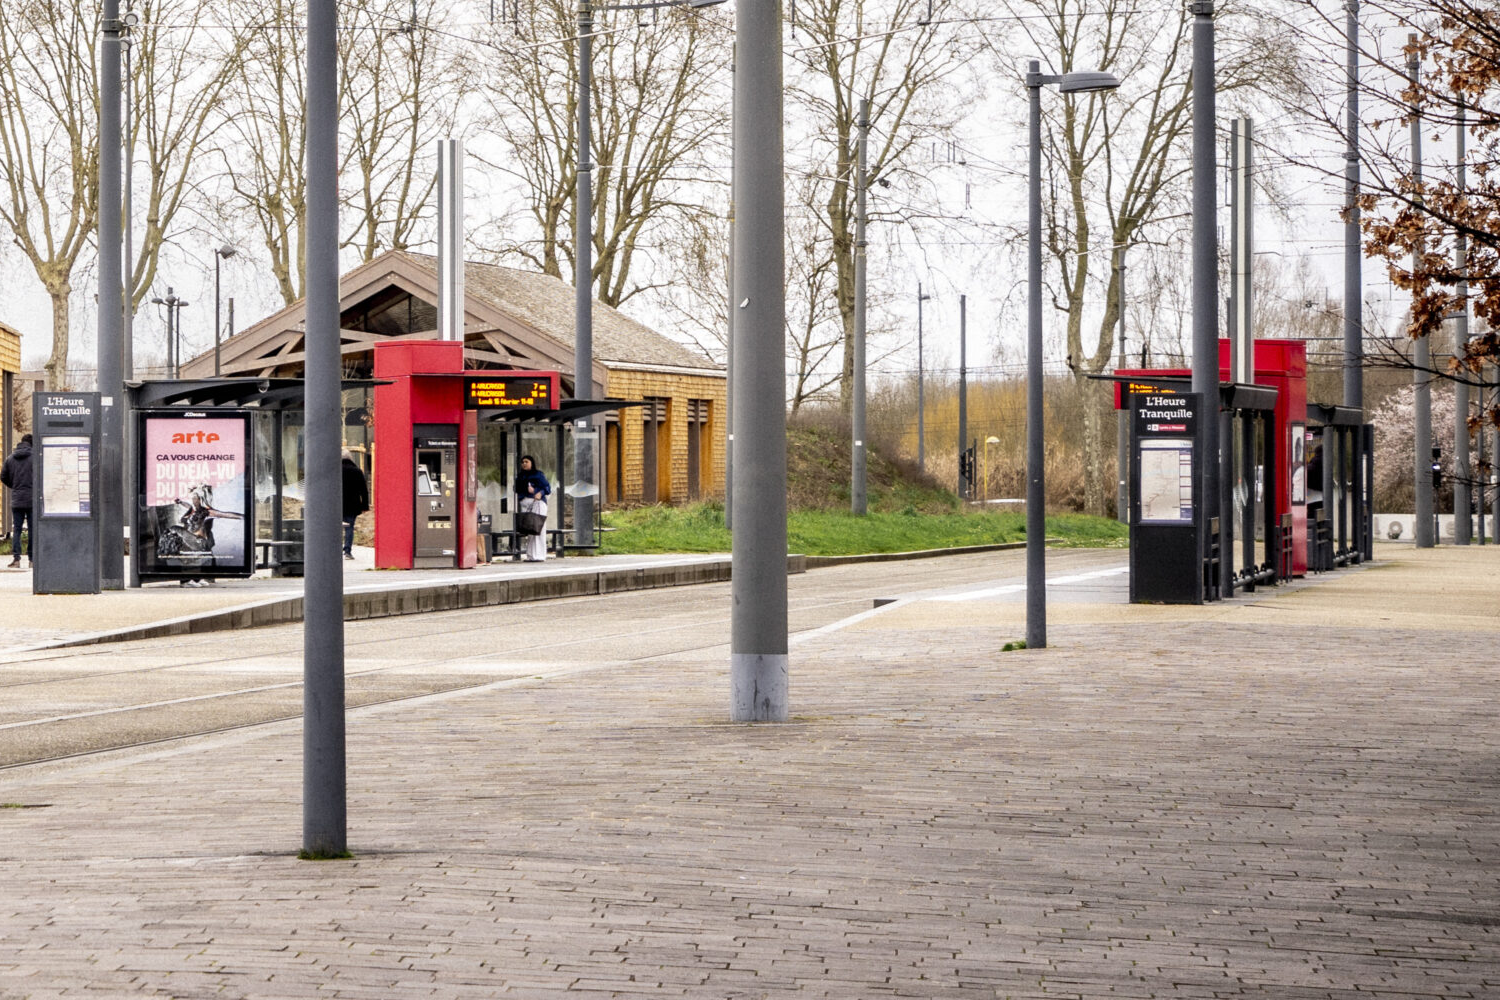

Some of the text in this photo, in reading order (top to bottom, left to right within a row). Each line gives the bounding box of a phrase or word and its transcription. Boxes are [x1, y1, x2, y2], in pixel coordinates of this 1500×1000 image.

[47, 397, 84, 406] L'Heure
[1146, 397, 1186, 406] L'Heure
[42, 407, 91, 417] Tranquille
[1139, 409, 1193, 420] Tranquille
[172, 431, 220, 443] arte
[156, 454, 169, 462] ÇA
[156, 463, 175, 479] DU
[156, 481, 175, 498] DU
